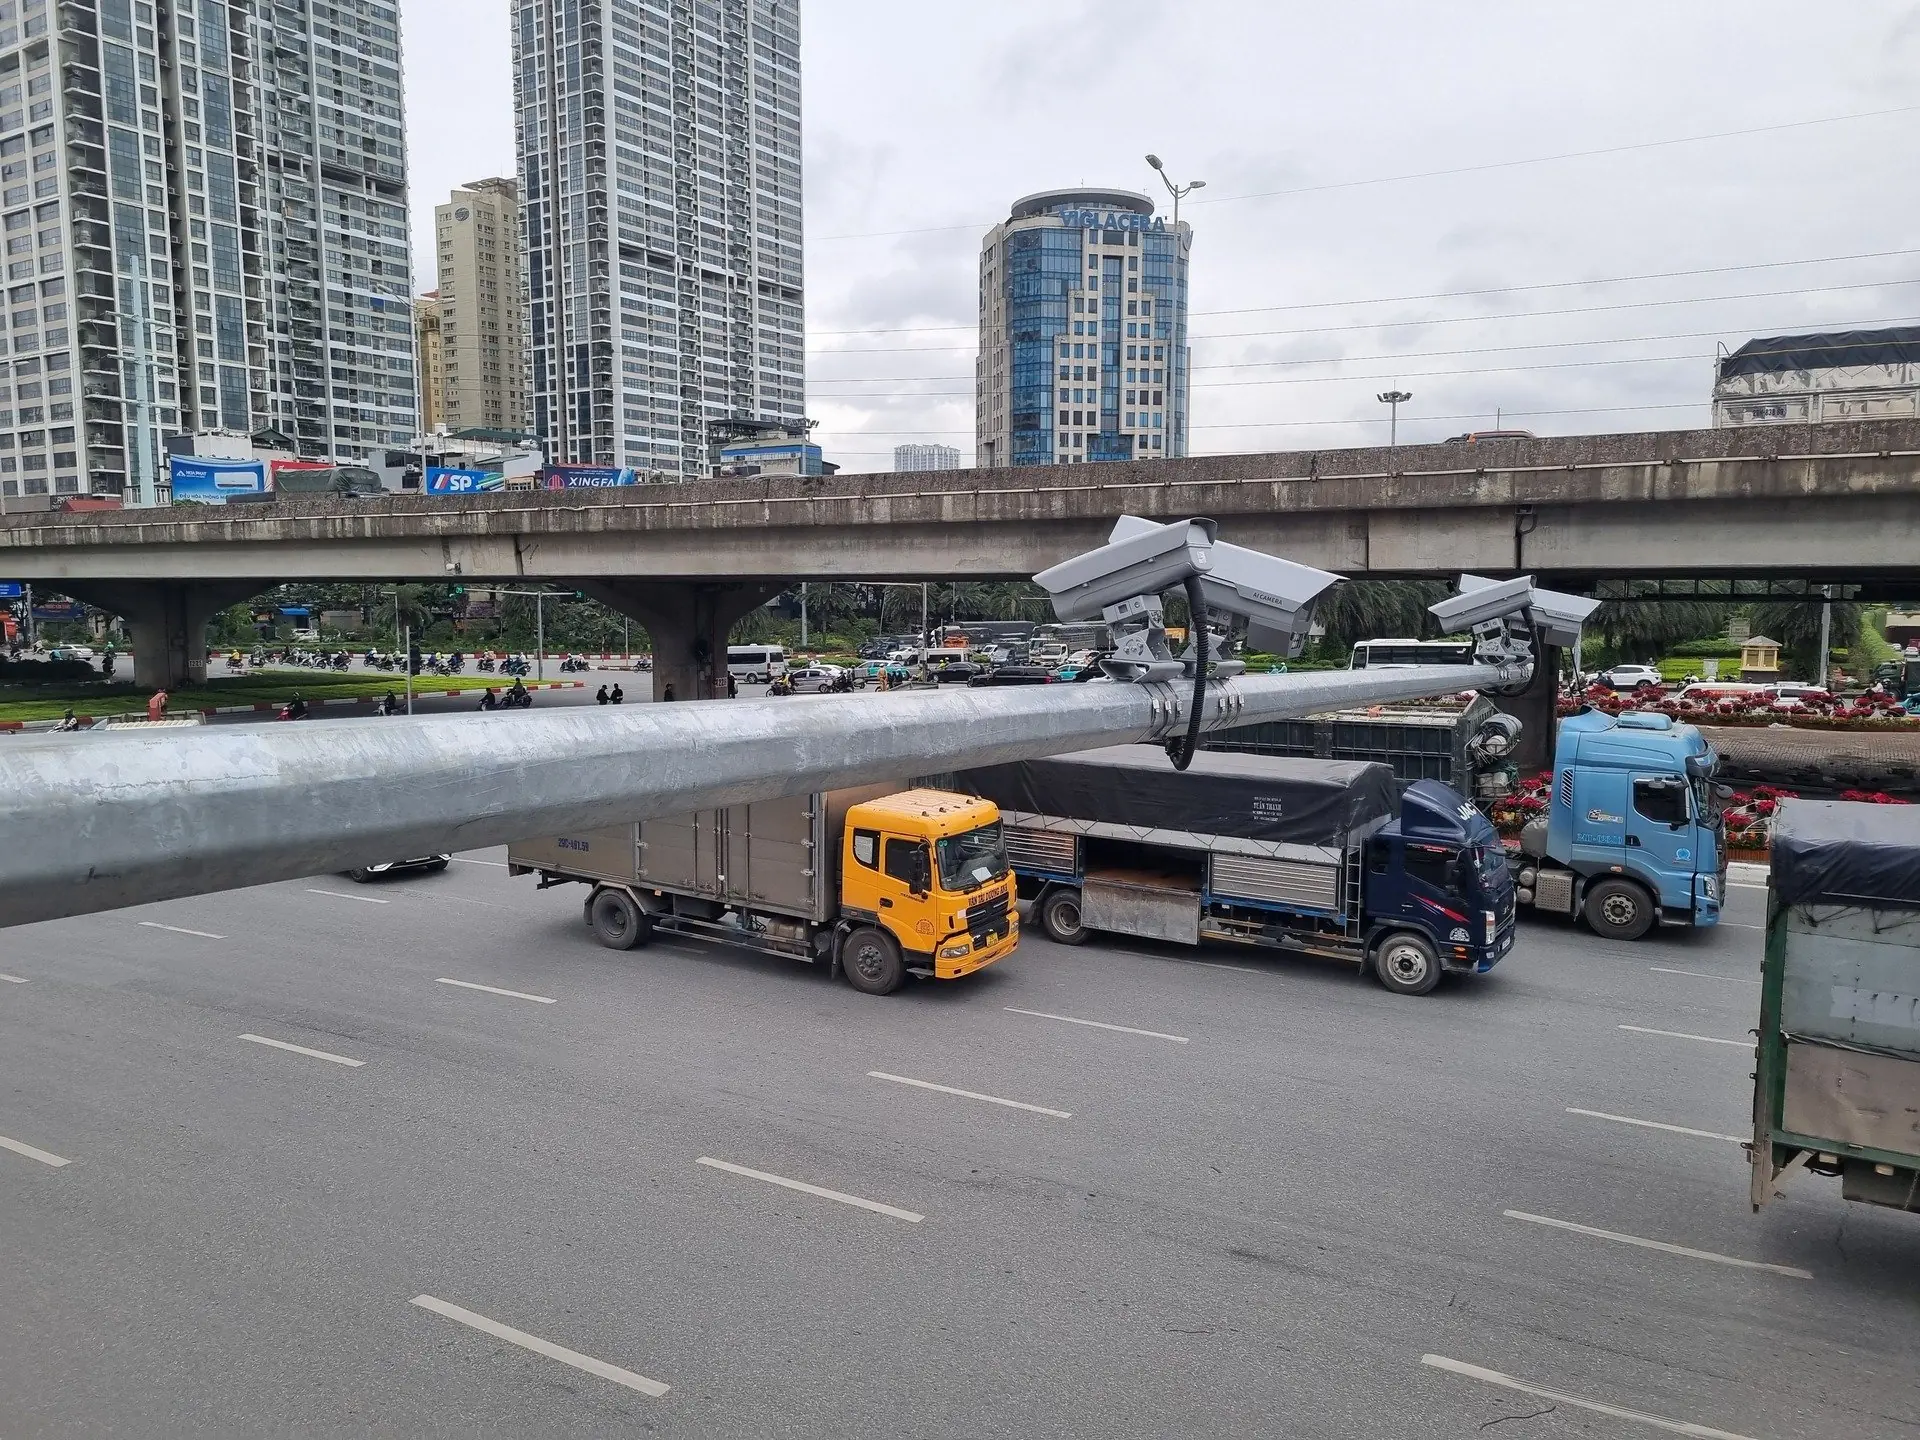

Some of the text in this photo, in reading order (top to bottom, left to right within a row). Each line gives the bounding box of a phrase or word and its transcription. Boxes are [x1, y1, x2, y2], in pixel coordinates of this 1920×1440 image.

[1060, 209, 1166, 233] VIGLACERA
[450, 474, 472, 491] SP
[568, 477, 615, 487] XINGFA
[1260, 594, 1283, 605] CAMERA
[1457, 802, 1476, 820] JAC
